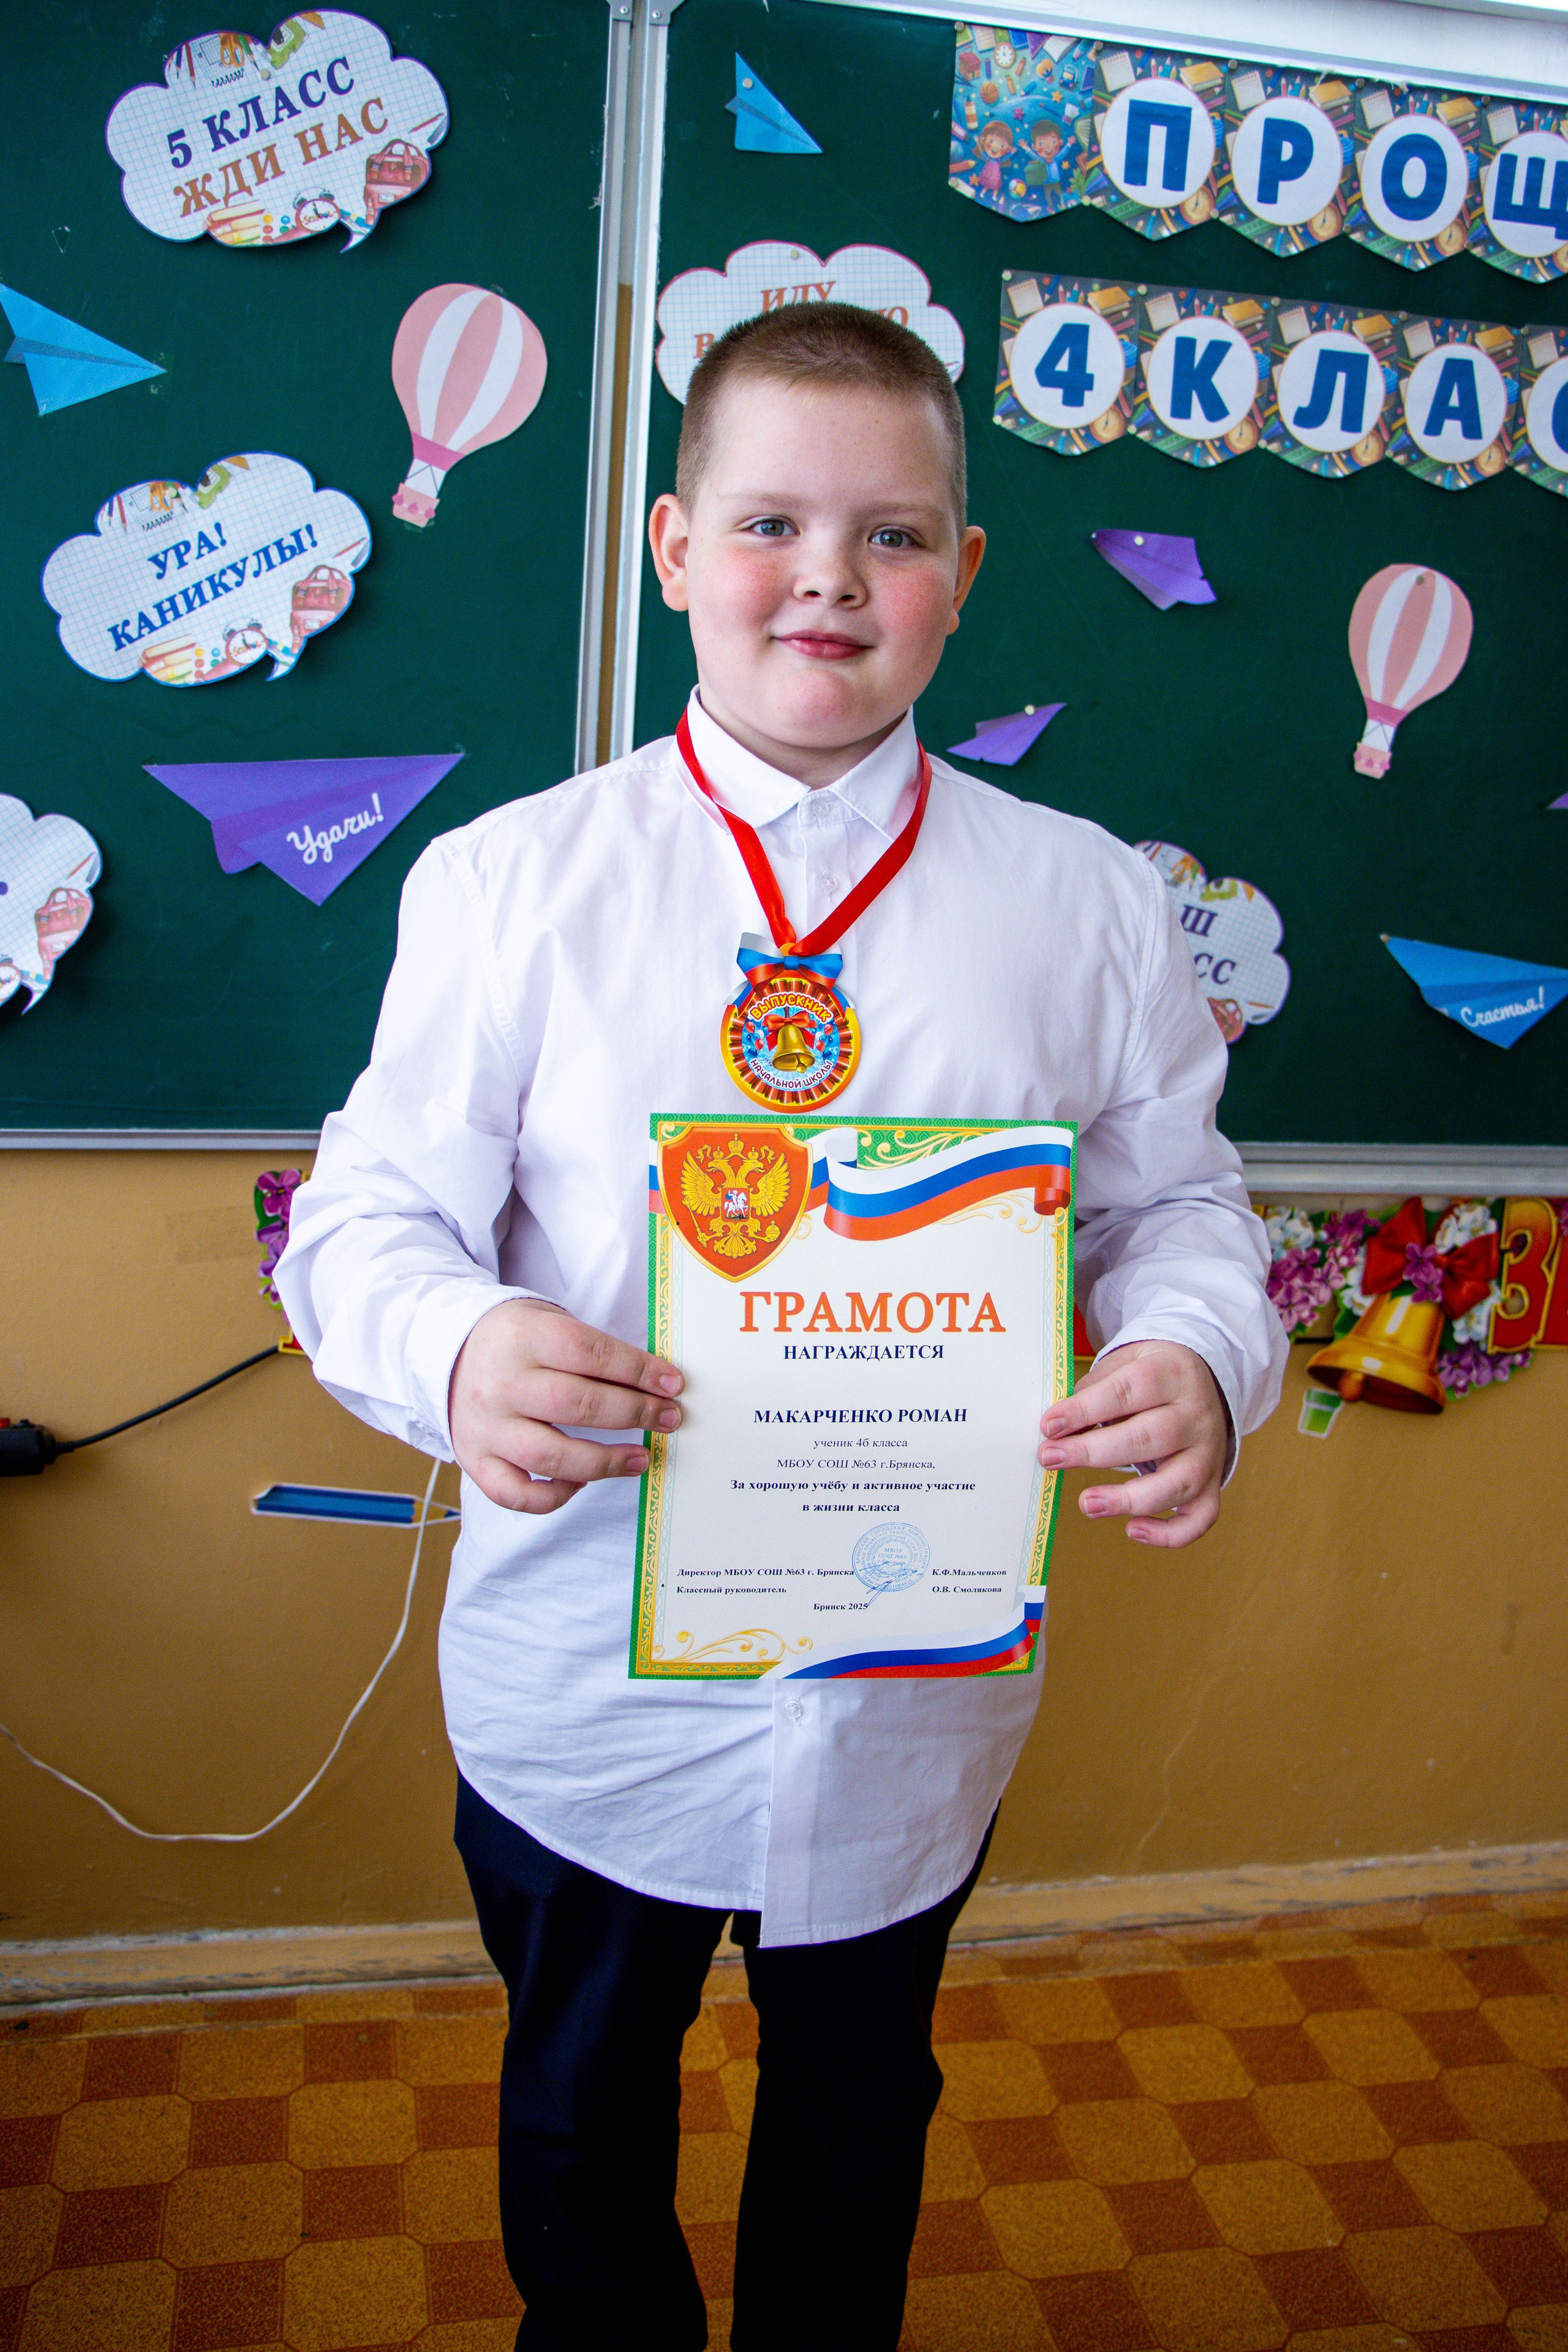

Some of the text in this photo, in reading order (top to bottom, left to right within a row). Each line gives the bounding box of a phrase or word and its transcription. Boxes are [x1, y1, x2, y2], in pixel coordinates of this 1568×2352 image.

[167, 56, 355, 169] 5 КЛАСС
[173, 97, 389, 217] ЖДИ НАС
[1035, 323, 1094, 407] 4
[147, 522, 228, 580] УРА!
[107, 524, 319, 651] КАНИКУЛЫ!
[287, 793, 385, 864] Удачи!
[750, 993, 832, 1022] ВЫПУСКНИК
[1461, 986, 1544, 1027] Счастья!
[750, 1059, 833, 1088] НАЧАЛЬНОЙ ШКОЛЫ
[740, 1292, 1006, 1333] ГРАМОТА
[783, 1345, 944, 1362] НАГРАЖДАЕТСЯ
[753, 1409, 968, 1423] МАКАРЧЕНКО РОМАН
[813, 1440, 853, 1449] ученик
[856, 1438, 869, 1447] 4б
[777, 1459, 935, 1470] МБОУ СОШ №63 г.Брянска,
[730, 1480, 745, 1489] За
[749, 1482, 809, 1491] хорошую
[812, 1480, 848, 1491] учёбу
[925, 1483, 976, 1492] участие
[677, 1569, 722, 1578] Директор
[816, 1569, 854, 1577] Брянска
